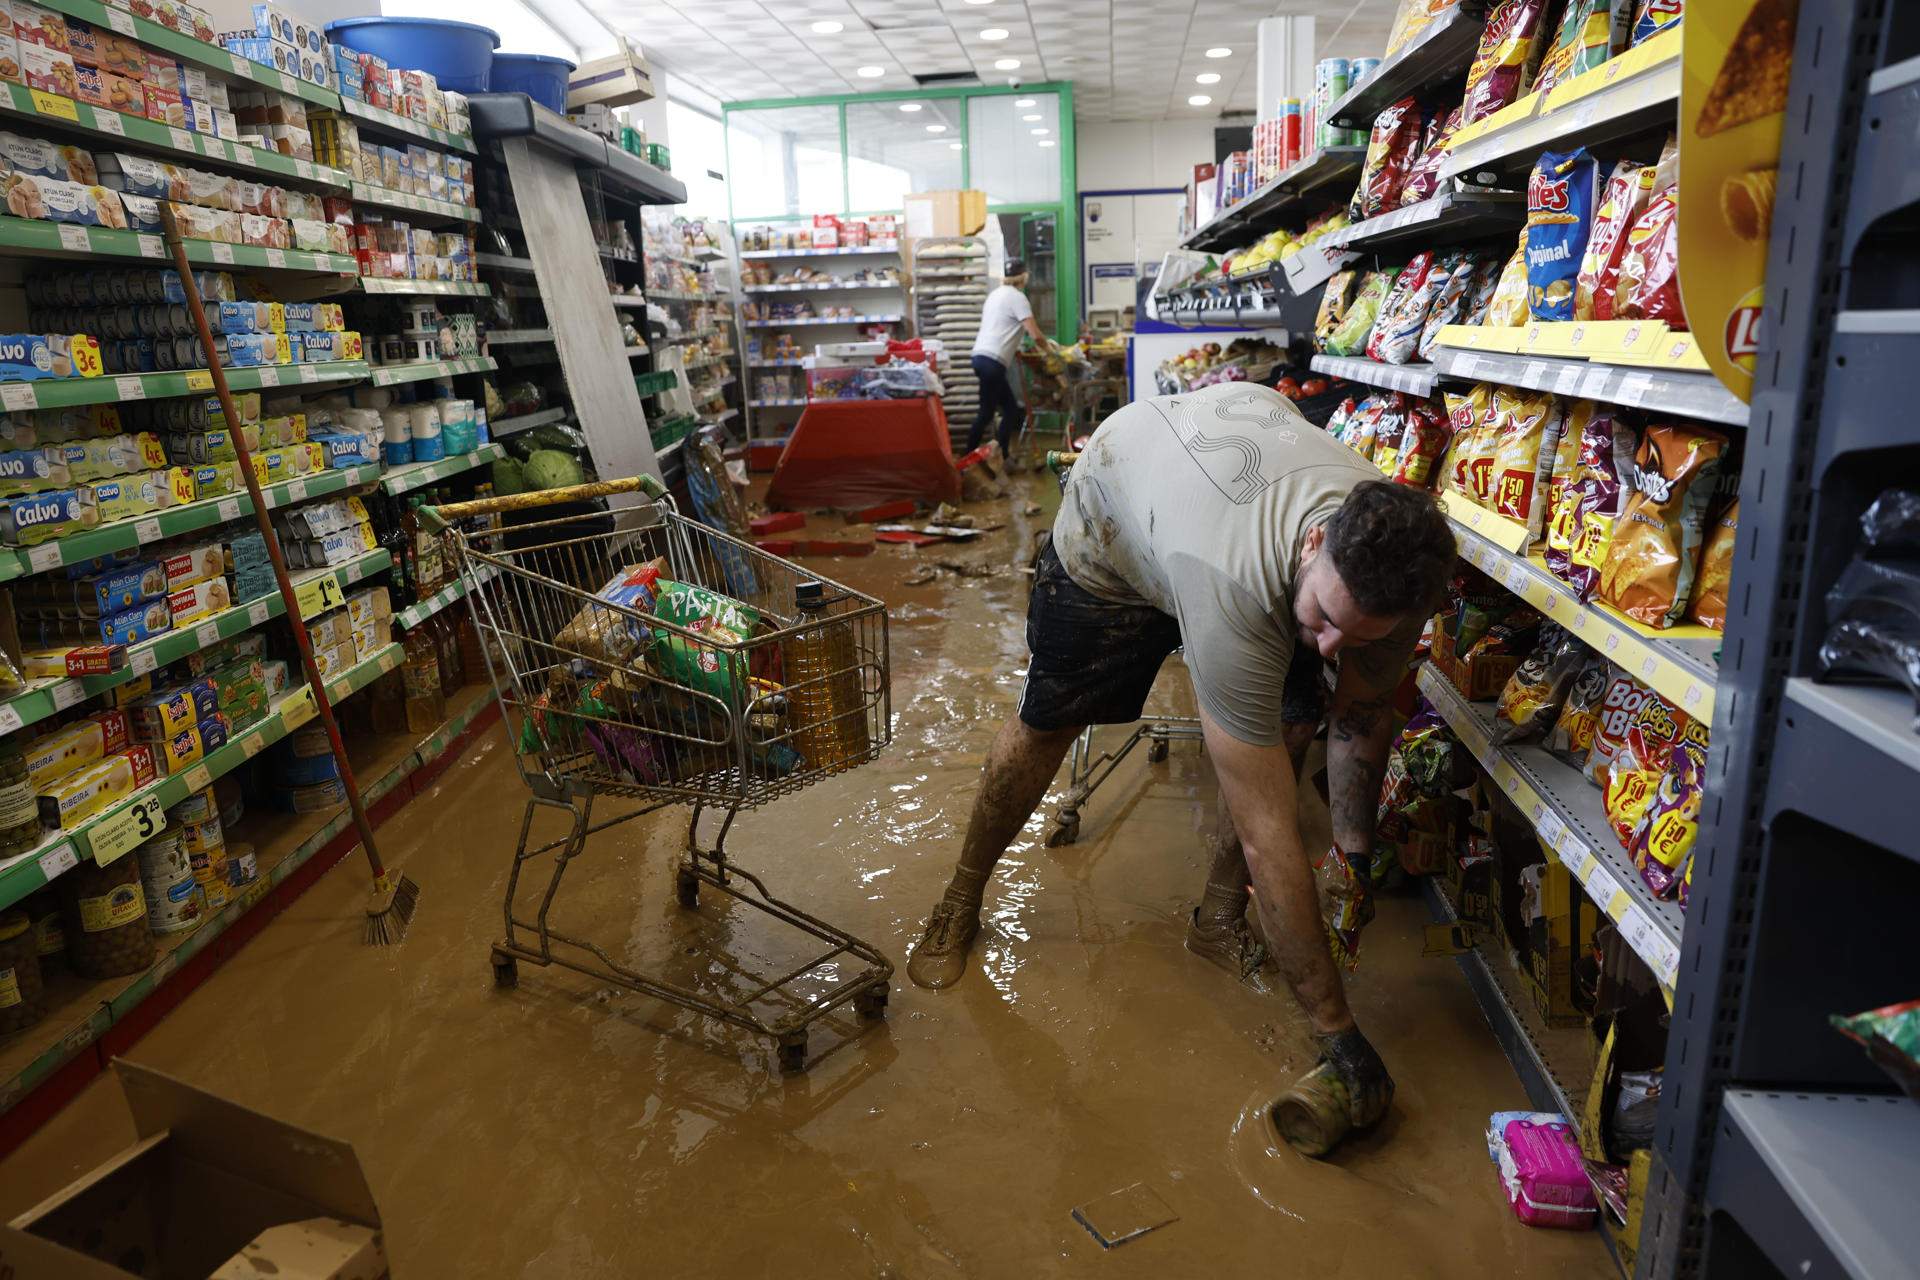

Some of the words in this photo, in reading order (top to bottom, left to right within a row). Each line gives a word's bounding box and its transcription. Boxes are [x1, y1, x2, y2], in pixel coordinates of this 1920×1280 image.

[1641, 169, 1656, 179] 80
[285, 305, 311, 320] Calvo
[305, 334, 331, 349] Calvo
[76, 348, 97, 372] 3€
[145, 444, 162, 464] 4€
[331, 440, 357, 456] Calvo
[197, 470, 216, 481] Calvo
[97, 487, 119, 497] Calvo
[176, 480, 192, 499] 4€
[1498, 476, 1524, 507] 1'50
[15, 503, 60, 527] Calvo
[305, 510, 330, 525] Calvo
[322, 537, 343, 553] Calvo
[68, 659, 85, 671] 3+1
[104, 713, 125, 738] 3+1
[171, 733, 196, 756] Isabel
[132, 747, 152, 771] 3+1
[61, 789, 90, 812] RIBEIRA
[1652, 815, 1687, 845] 1'50
[1659, 838, 1673, 855] €
